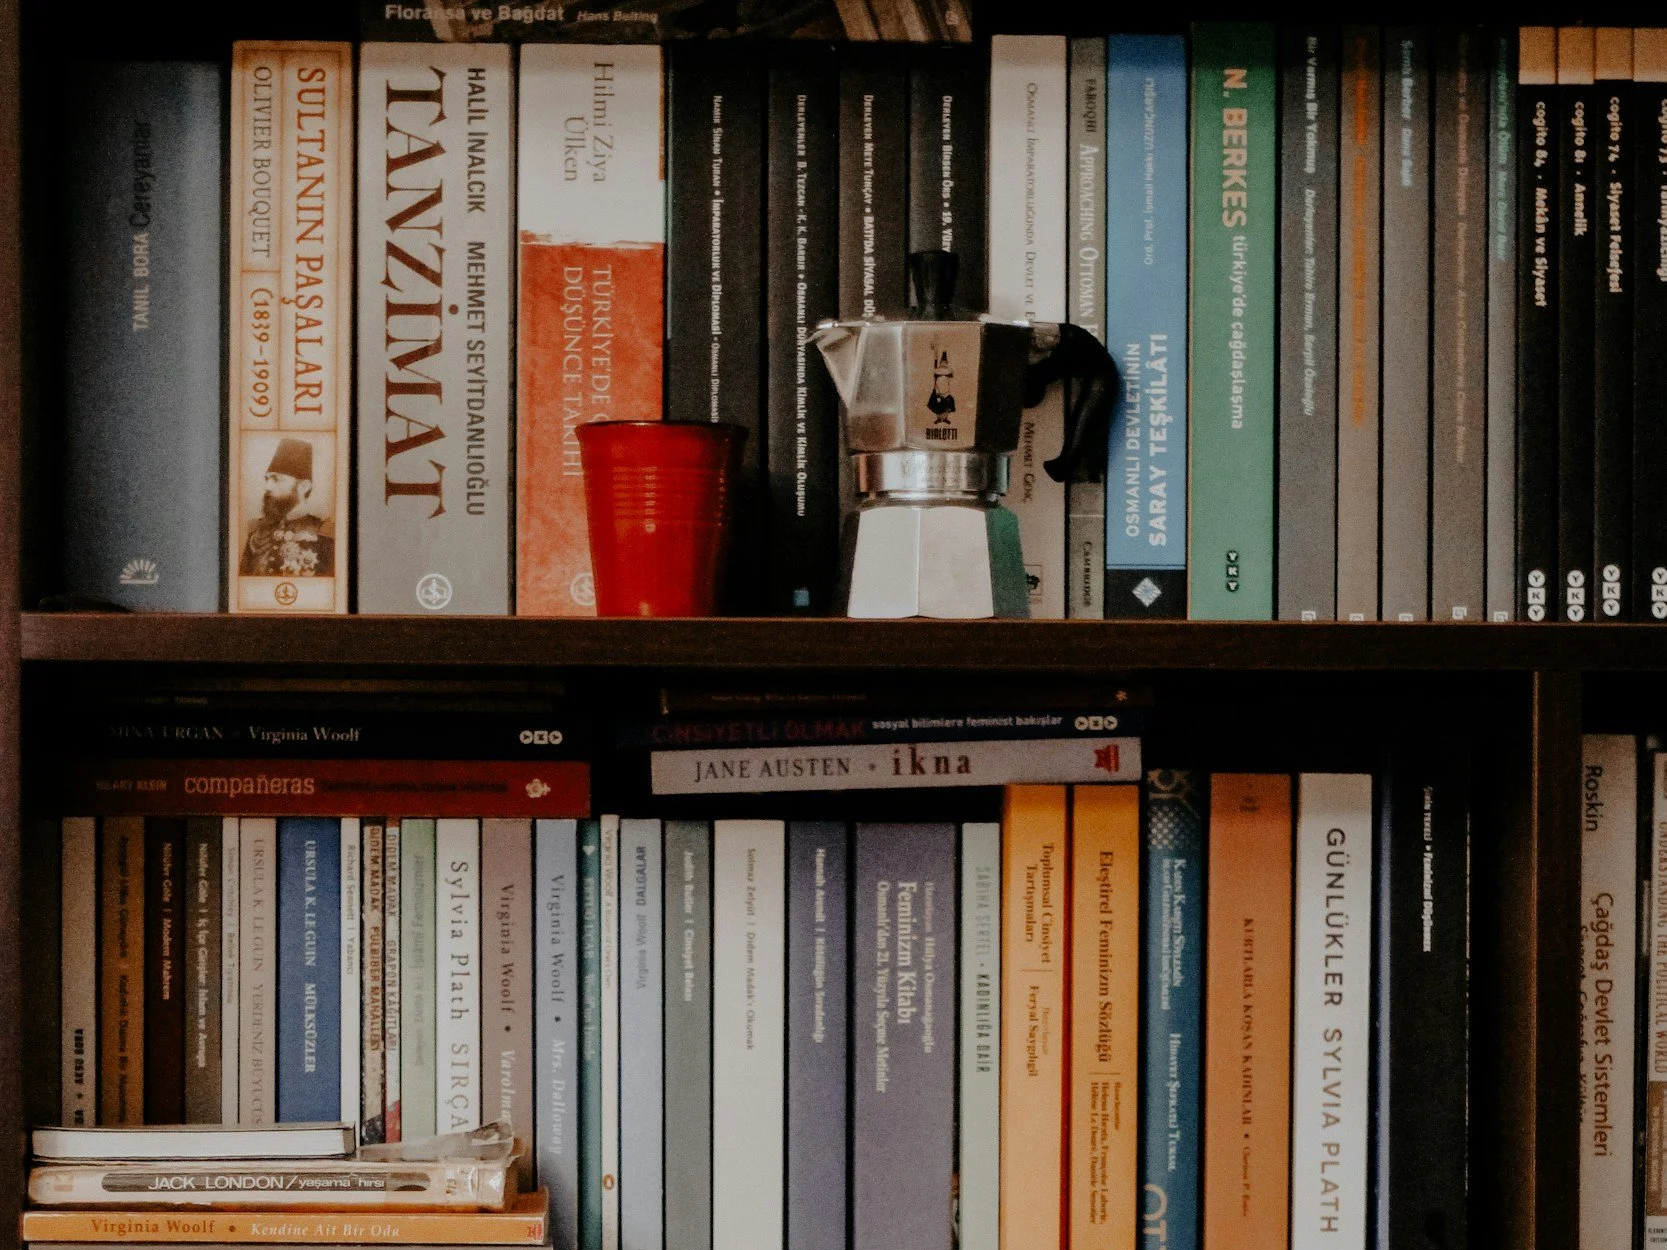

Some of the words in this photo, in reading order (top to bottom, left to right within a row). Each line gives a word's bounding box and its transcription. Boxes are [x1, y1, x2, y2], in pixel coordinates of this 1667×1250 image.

[251, 66, 273, 150] OLIVIER
[468, 68, 488, 124] HALİL
[593, 62, 614, 129] Hilmi
[1223, 68, 1247, 95] N.
[296, 67, 326, 243] SULTANIN
[565, 117, 588, 181] Ülken
[587, 136, 612, 182] Ziya
[1533, 102, 1548, 146] cogito
[1534, 150, 1548, 167] 84
[1571, 102, 1587, 146] cogito
[1575, 150, 1586, 163] 81
[467, 132, 488, 212] İNALCIK
[1222, 108, 1247, 227] BERKES
[248, 159, 271, 257] BOUQUET
[1574, 183, 1587, 236] Annelik
[1230, 236, 1247, 317] türkiye'de
[1532, 257, 1548, 306] Siyaset
[1535, 237, 1545, 254] ve
[381, 65, 458, 518] TANZİMAT
[467, 242, 485, 332] MEHMET
[283, 254, 323, 414] PAŞALARI
[561, 267, 585, 384] DÜŞÜNCE
[591, 265, 615, 404] TÜRKİYE'DE
[1123, 344, 1140, 450] DEVLETİNİN
[1229, 322, 1246, 428] çağdaşlaşma
[466, 340, 488, 515] SEYİTDANLIOĞLU
[1126, 457, 1140, 537] OSMANLI
[185, 775, 314, 798] compañeras
[694, 760, 751, 782] JANE
[761, 758, 851, 778] AUSTEN
[893, 744, 971, 776] ikna
[1584, 765, 1606, 832] Roskin
[445, 861, 470, 938] Sylvia
[547, 875, 564, 944] Virginia
[1096, 851, 1114, 914] Eleştirel
[1325, 828, 1348, 1005] GÜNLÜKLER
[898, 882, 917, 966] Feminizm
[1099, 920, 1113, 996] Feminizm
[1590, 893, 1614, 971] Çağdaş
[451, 954, 470, 1019] Plath
[551, 953, 564, 1002] Woolf
[898, 971, 917, 1024] Kitabı
[1594, 979, 1613, 1045] Devlet
[552, 1039, 565, 1072] Mrs.
[1096, 1002, 1112, 1062] Sözlüğü
[445, 1044, 469, 1129] SIRÇA
[1322, 1029, 1342, 1128] SYLVIA
[1594, 1054, 1613, 1156] Sistemleri
[547, 1079, 565, 1158] Dalloway
[148, 1176, 195, 1190] JACK
[205, 1176, 284, 1190] LONDON
[358, 1178, 387, 1188] hırsı
[1320, 1143, 1340, 1232] PLATH
[92, 1220, 159, 1239] Virginia
[167, 1220, 215, 1235] Woolf
[252, 1223, 311, 1236] Kendine
[314, 1222, 337, 1236] Ait
[343, 1224, 365, 1236] Bir
[371, 1224, 400, 1237] Oda
